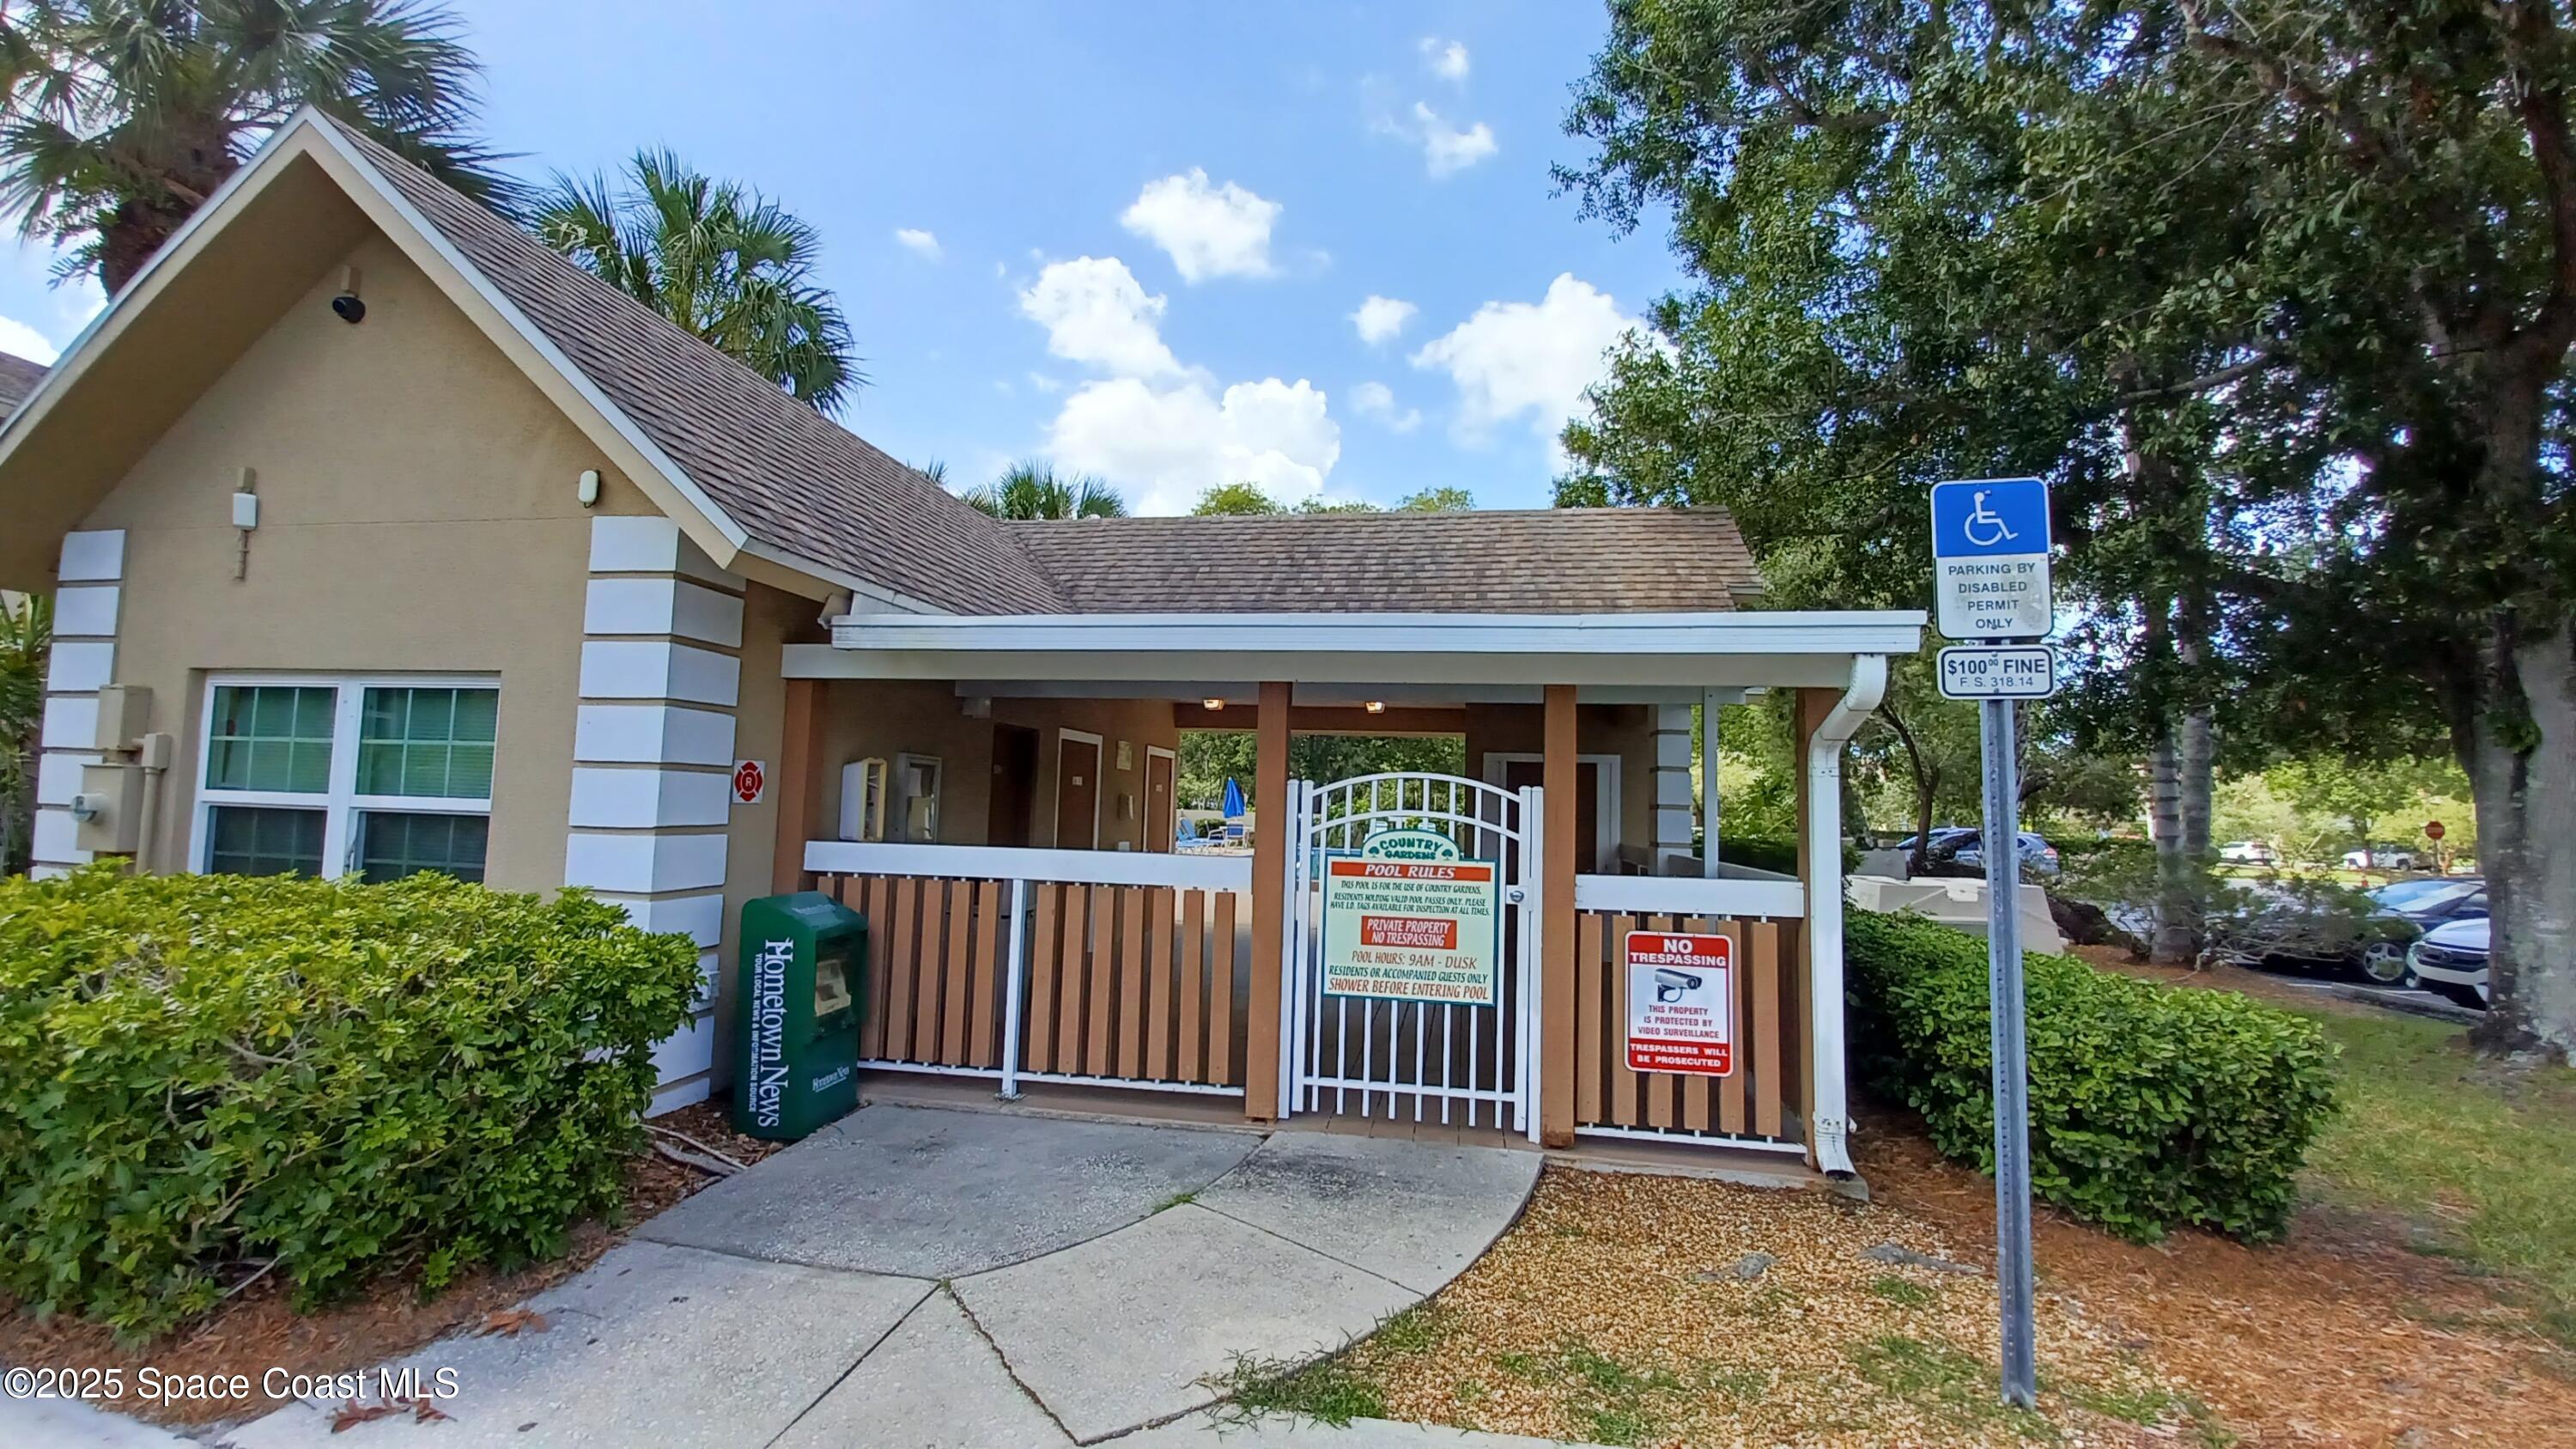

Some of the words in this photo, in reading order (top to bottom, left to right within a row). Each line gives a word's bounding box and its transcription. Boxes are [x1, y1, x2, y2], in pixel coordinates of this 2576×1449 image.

[1948, 564, 2011, 575] PARKING
[2018, 563, 2035, 574] BY
[1959, 581, 2027, 594] DISABLED
[1968, 600, 2019, 611] PERMIT
[1976, 618, 2013, 630] ONLY
[2003, 659, 2045, 673] FINE
[1960, 677, 1970, 687] F.
[1975, 677, 1985, 687] S.
[1990, 677, 2033, 687] 318.14
[745, 776, 752, 787] R
[1379, 837, 1443, 852] COUNTRY
[1385, 851, 1437, 860] GARDENS
[1365, 865, 1402, 877] POOL
[1407, 867, 1455, 879] RULES
[1341, 880, 1354, 889] THIS
[1355, 880, 1370, 890] POOL
[1404, 883, 1414, 892] USE
[1425, 884, 1452, 892] COUNTRY
[1334, 892, 1364, 901] RESIDENTS
[1365, 893, 1389, 902] HOLDING
[1416, 905, 1449, 914] INSPECTION
[1367, 919, 1403, 932] PRIVATE
[1405, 921, 1451, 935] PROPERTY
[1371, 933, 1385, 944] NO
[1387, 933, 1445, 947] TRESPASSING
[1663, 939, 1692, 953] NO
[754, 953, 762, 973] YOUR
[1352, 951, 1372, 963] POOL
[1376, 952, 1405, 965] HOURS:
[1409, 954, 1434, 967] 9AM
[1445, 956, 1477, 970] DUSK
[1631, 953, 1726, 966] TRESPASSING
[1329, 965, 1368, 977] RESIDENTS
[1370, 967, 1381, 977] OR
[1382, 968, 1437, 981] ACCOMPANIED
[1438, 972, 1466, 983] GUESTS
[1467, 973, 1488, 983] ONLY
[753, 975, 762, 998] LOCAL
[1328, 977, 1370, 992] SHOWER
[1372, 981, 1409, 995] BEFORE
[1412, 983, 1461, 997] ENTERING
[1463, 986, 1488, 1000] POOL
[761, 937, 793, 1062] Hometown
[752, 1000, 761, 1022] NEWS
[1668, 1006, 1708, 1015] PROPERTY
[1656, 1017, 1698, 1026] PROTECTED
[1637, 1026, 1660, 1035] VIDEO
[1664, 1028, 1719, 1038] SURVEILLANCE
[1630, 1044, 1698, 1054] TRESPASSERS
[1704, 1048, 1728, 1056] WILL
[1656, 1056, 1721, 1067] PROSECUTED
[749, 1082, 757, 1112] SOURCE
[758, 1064, 789, 1127] News
